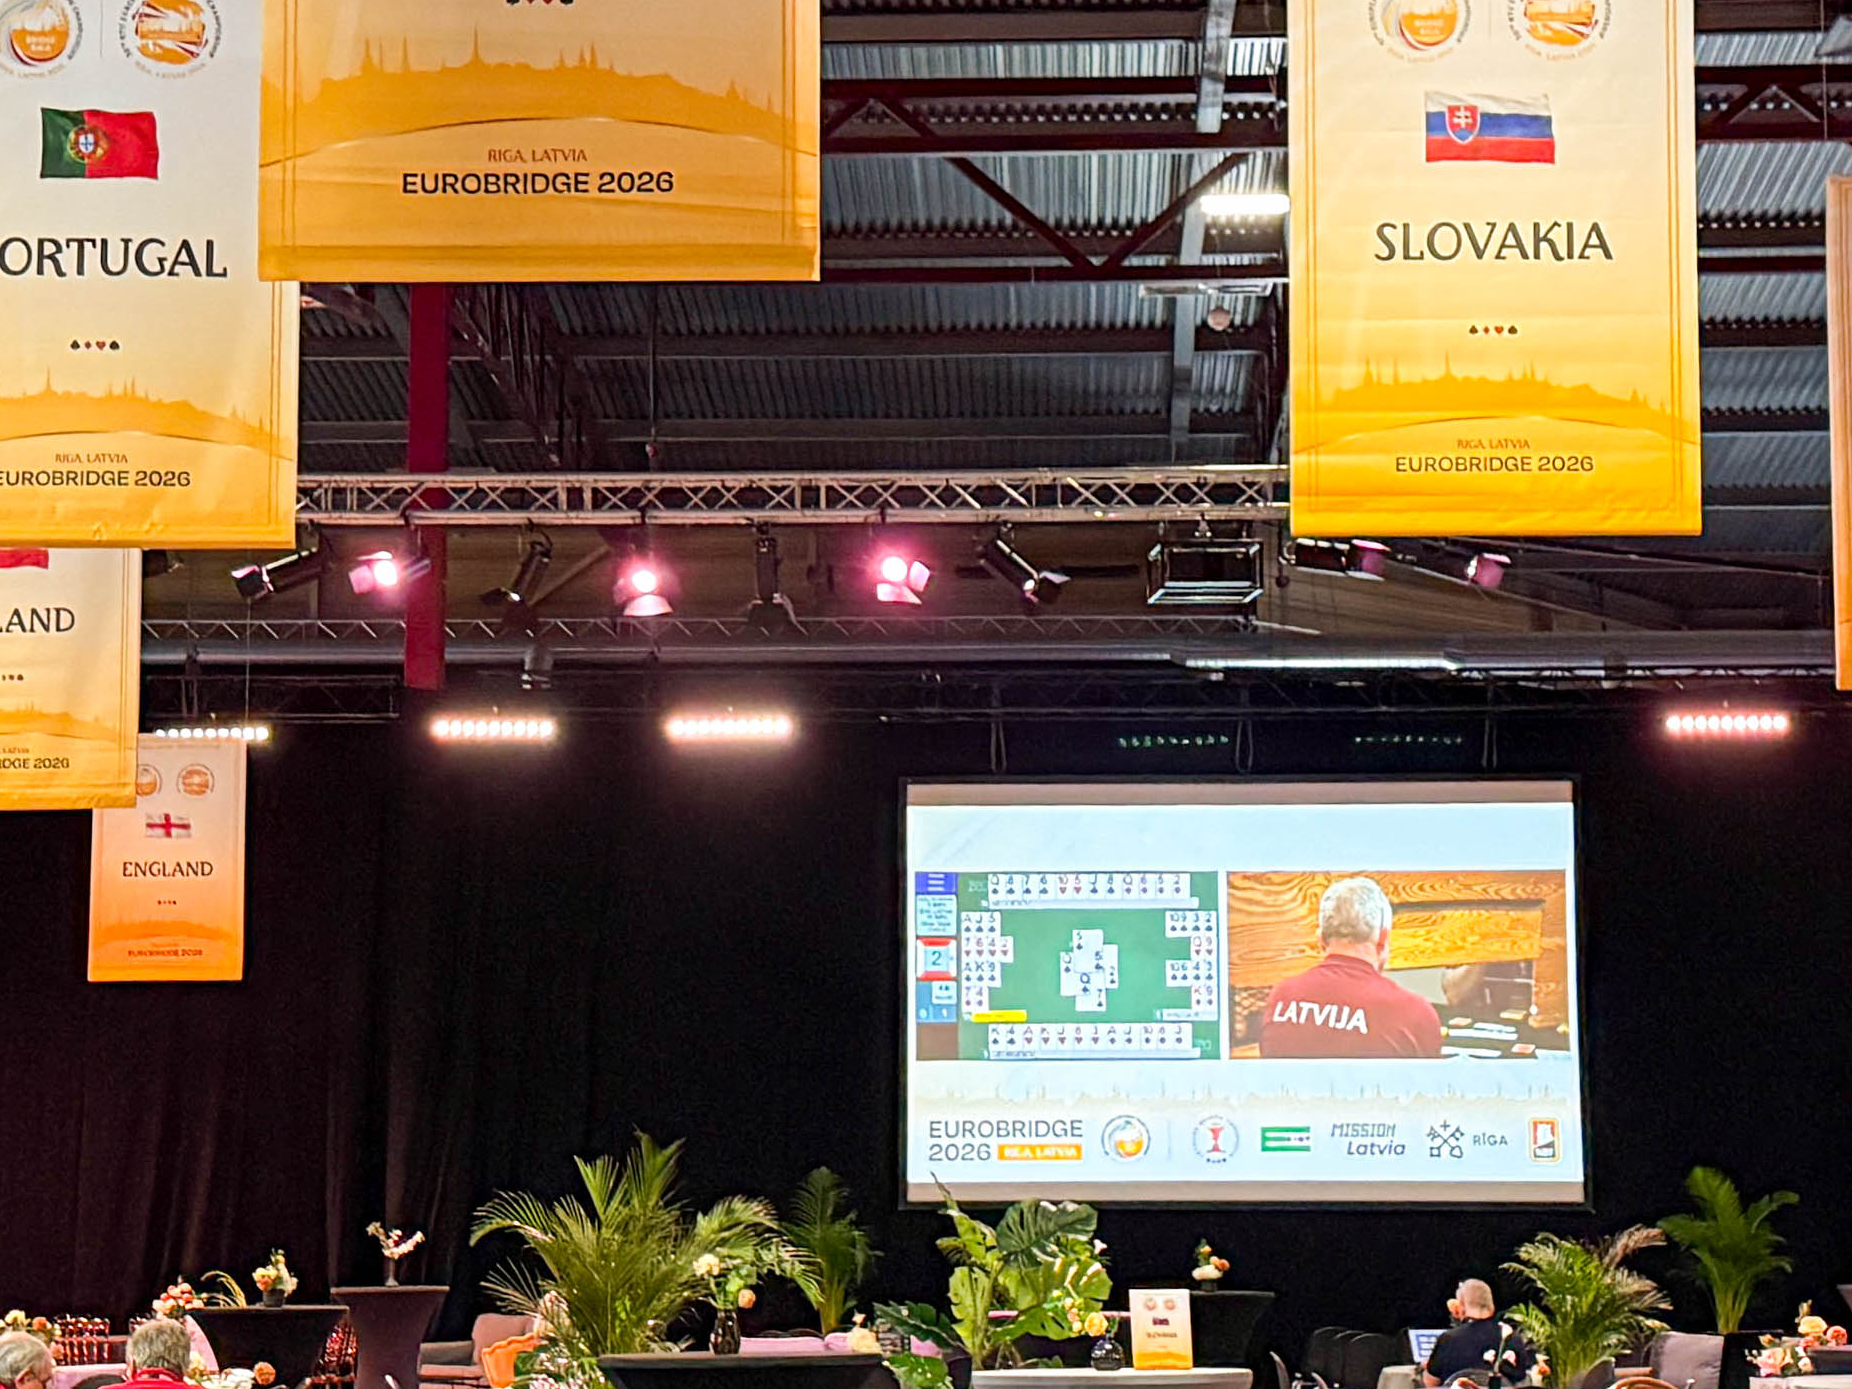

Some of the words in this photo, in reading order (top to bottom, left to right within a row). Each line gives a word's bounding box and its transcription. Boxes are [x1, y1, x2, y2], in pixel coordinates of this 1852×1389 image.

[487, 148, 527, 164] RIGA,
[531, 147, 588, 163] LATVIA
[401, 171, 591, 195] EUROBRIDGE
[597, 170, 675, 194] 2026
[1374, 220, 1615, 262] SLOVAKIA
[1488, 438, 1531, 450] LATVIA
[86, 453, 129, 464] LATVIA
[1395, 455, 1532, 473] EUROBRIDGE
[1537, 455, 1594, 472] 2026
[134, 470, 191, 487] 2026
[33, 758, 71, 770] 2026
[122, 861, 214, 878] ENGLAND
[931, 950, 942, 966] 2
[1080, 972, 1091, 984] Q
[1272, 1000, 1368, 1035] LATVIJA
[928, 1119, 1083, 1139] EUROBRIDGE
[1330, 1122, 1396, 1137] MISSION
[928, 1143, 991, 1161] 2026
[1346, 1139, 1406, 1156] Latvia
